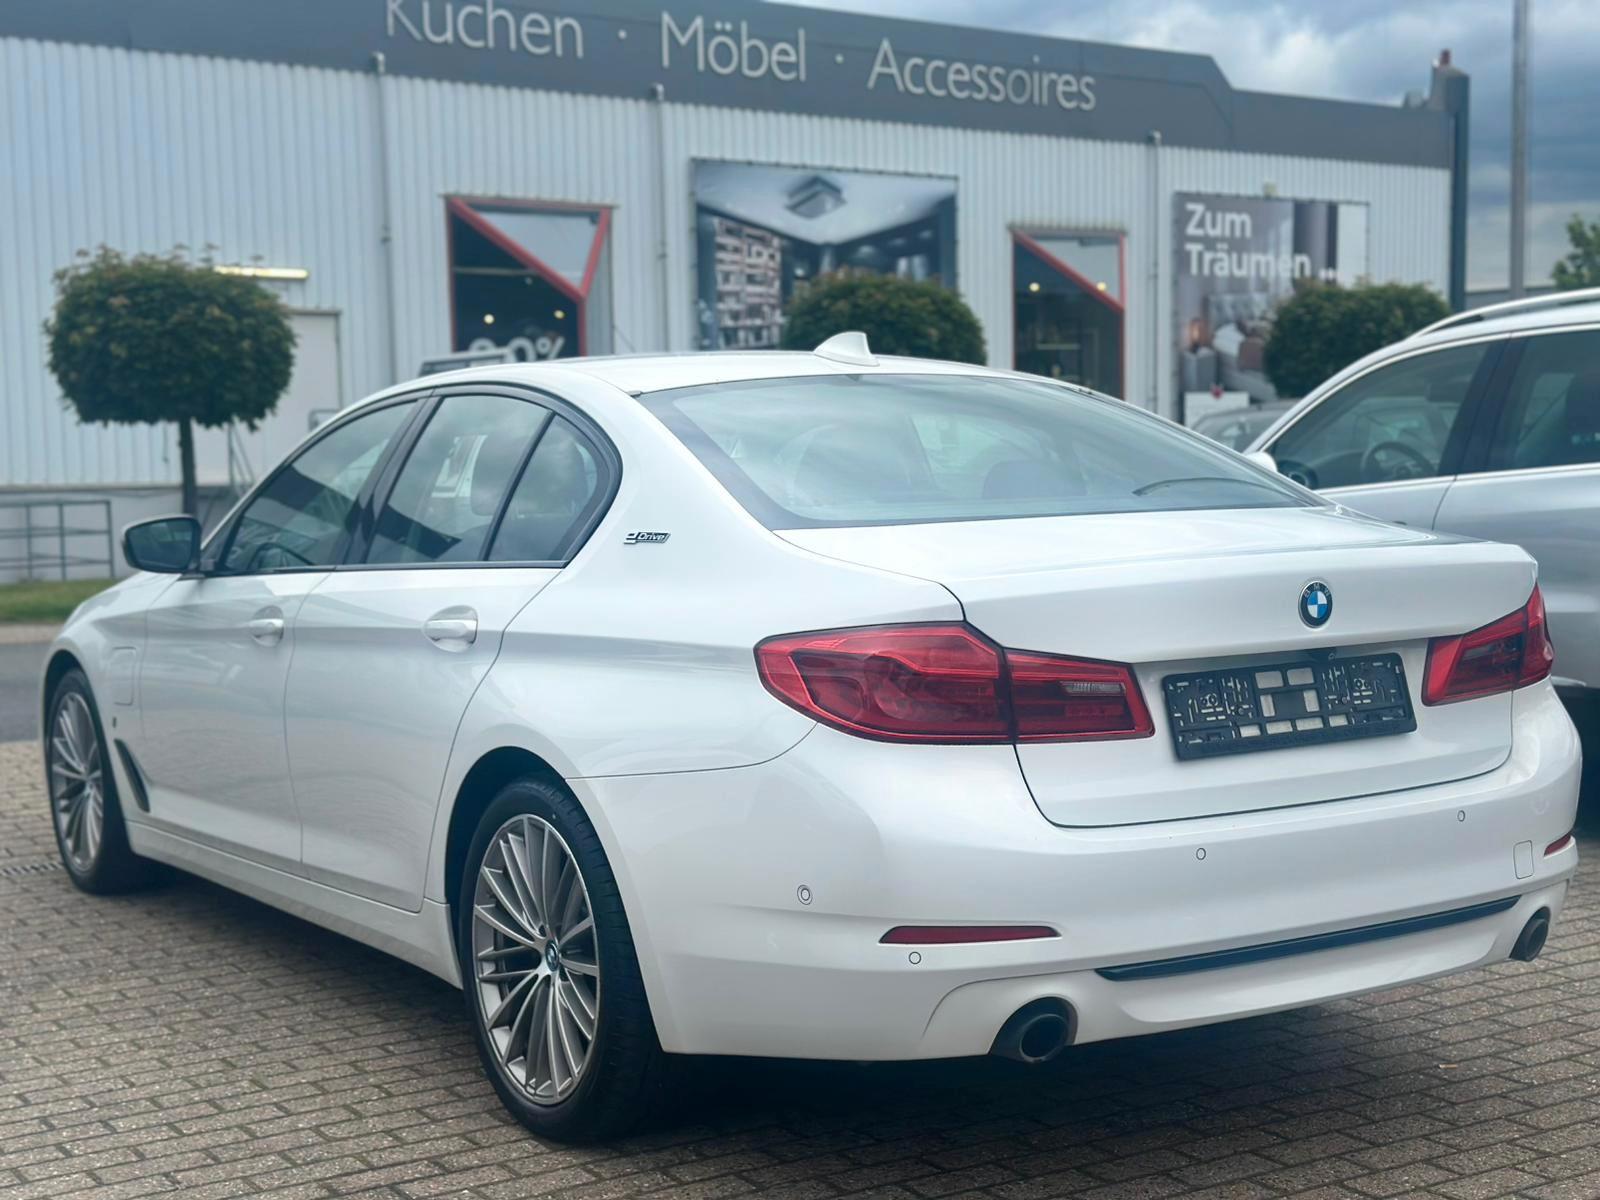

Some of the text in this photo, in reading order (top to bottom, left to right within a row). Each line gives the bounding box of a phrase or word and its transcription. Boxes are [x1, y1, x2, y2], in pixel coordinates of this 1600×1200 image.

[661, 10, 807, 82] Möbel
[867, 37, 1097, 111] Accessoires
[1184, 203, 1253, 239] Zum
[1184, 243, 1312, 280] Träumen
